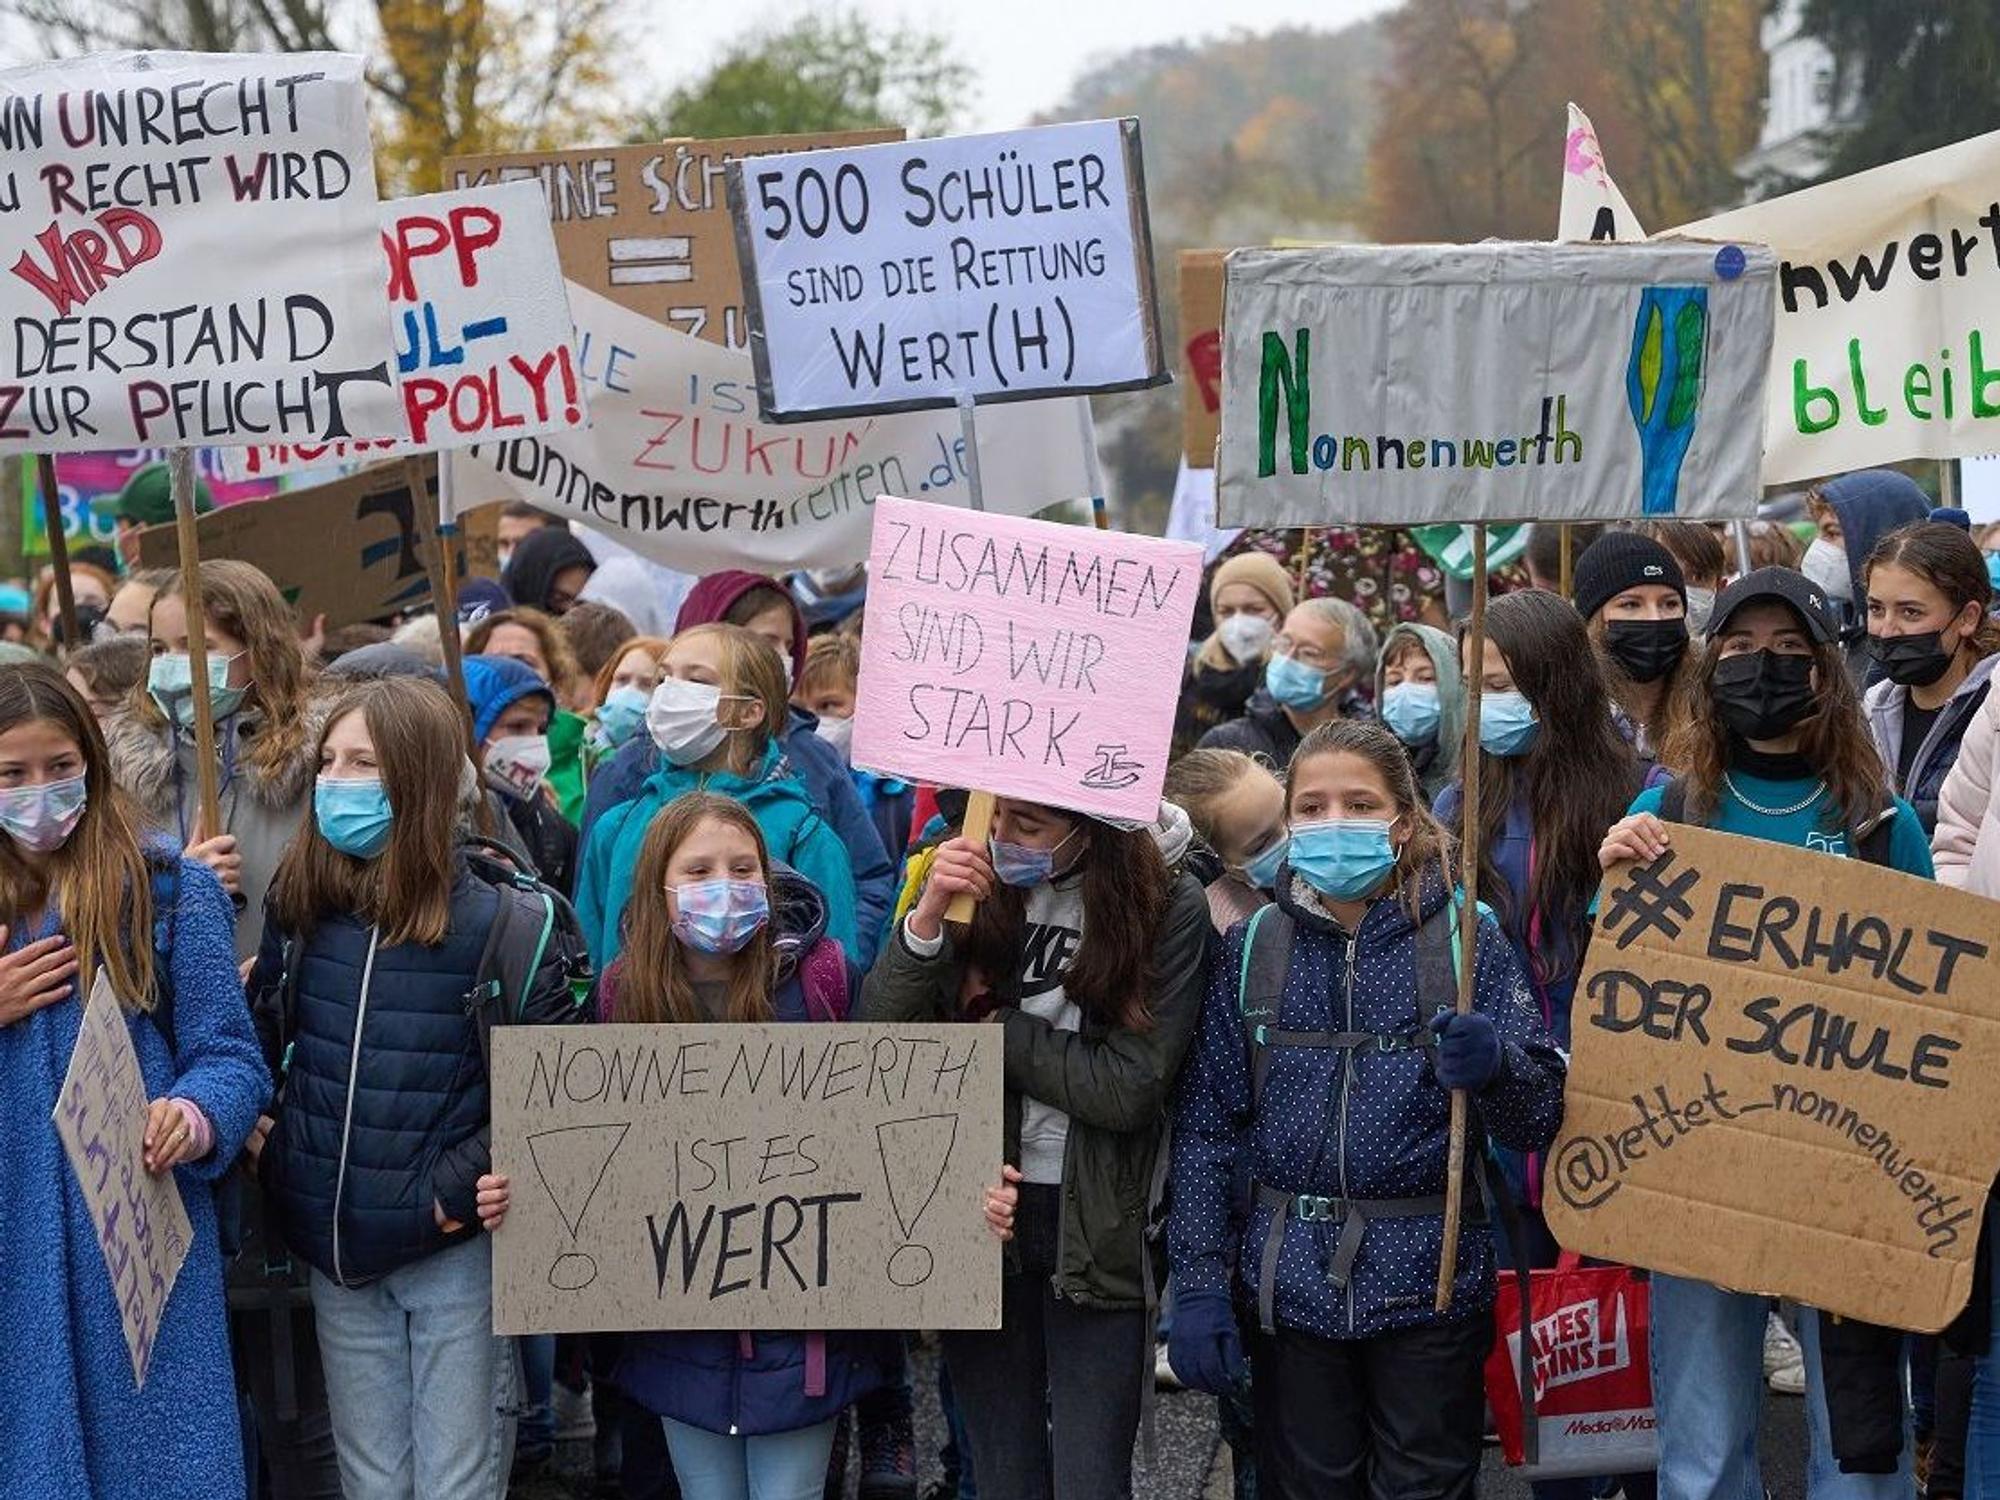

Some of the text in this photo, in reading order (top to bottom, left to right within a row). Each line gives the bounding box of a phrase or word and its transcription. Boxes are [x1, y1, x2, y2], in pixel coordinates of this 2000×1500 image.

[57, 72, 325, 150] UNRECHT
[40, 157, 210, 215] RECHT
[225, 150, 351, 203] WIRD
[455, 158, 618, 222] INE
[757, 150, 1112, 241] 500 SCHÜLER
[10, 207, 163, 317] WIRD
[787, 236, 1106, 307] SIND DIE RETTUNG
[15, 295, 335, 378] DERSTAND
[830, 295, 1076, 389] WERT(H)
[0, 361, 391, 443] ZUR PFLICHT
[691, 373, 757, 414] IS
[1257, 327, 1584, 479] Nonnenwerth
[1792, 329, 2000, 435] bleib
[882, 520, 1181, 619] ZUSAMMEN
[890, 601, 1106, 695] SIND WIR
[902, 683, 1082, 768] STARK
[1585, 969, 1712, 1047] DER
[1725, 996, 1962, 1089] SCHULE
[523, 1037, 978, 1110] NONNENWERTH
[674, 1136, 747, 1196] IST
[758, 1133, 821, 1185] ES
[1554, 1072, 1975, 1259] @rettet_nonnenwerth
[645, 1191, 863, 1301] WERT
